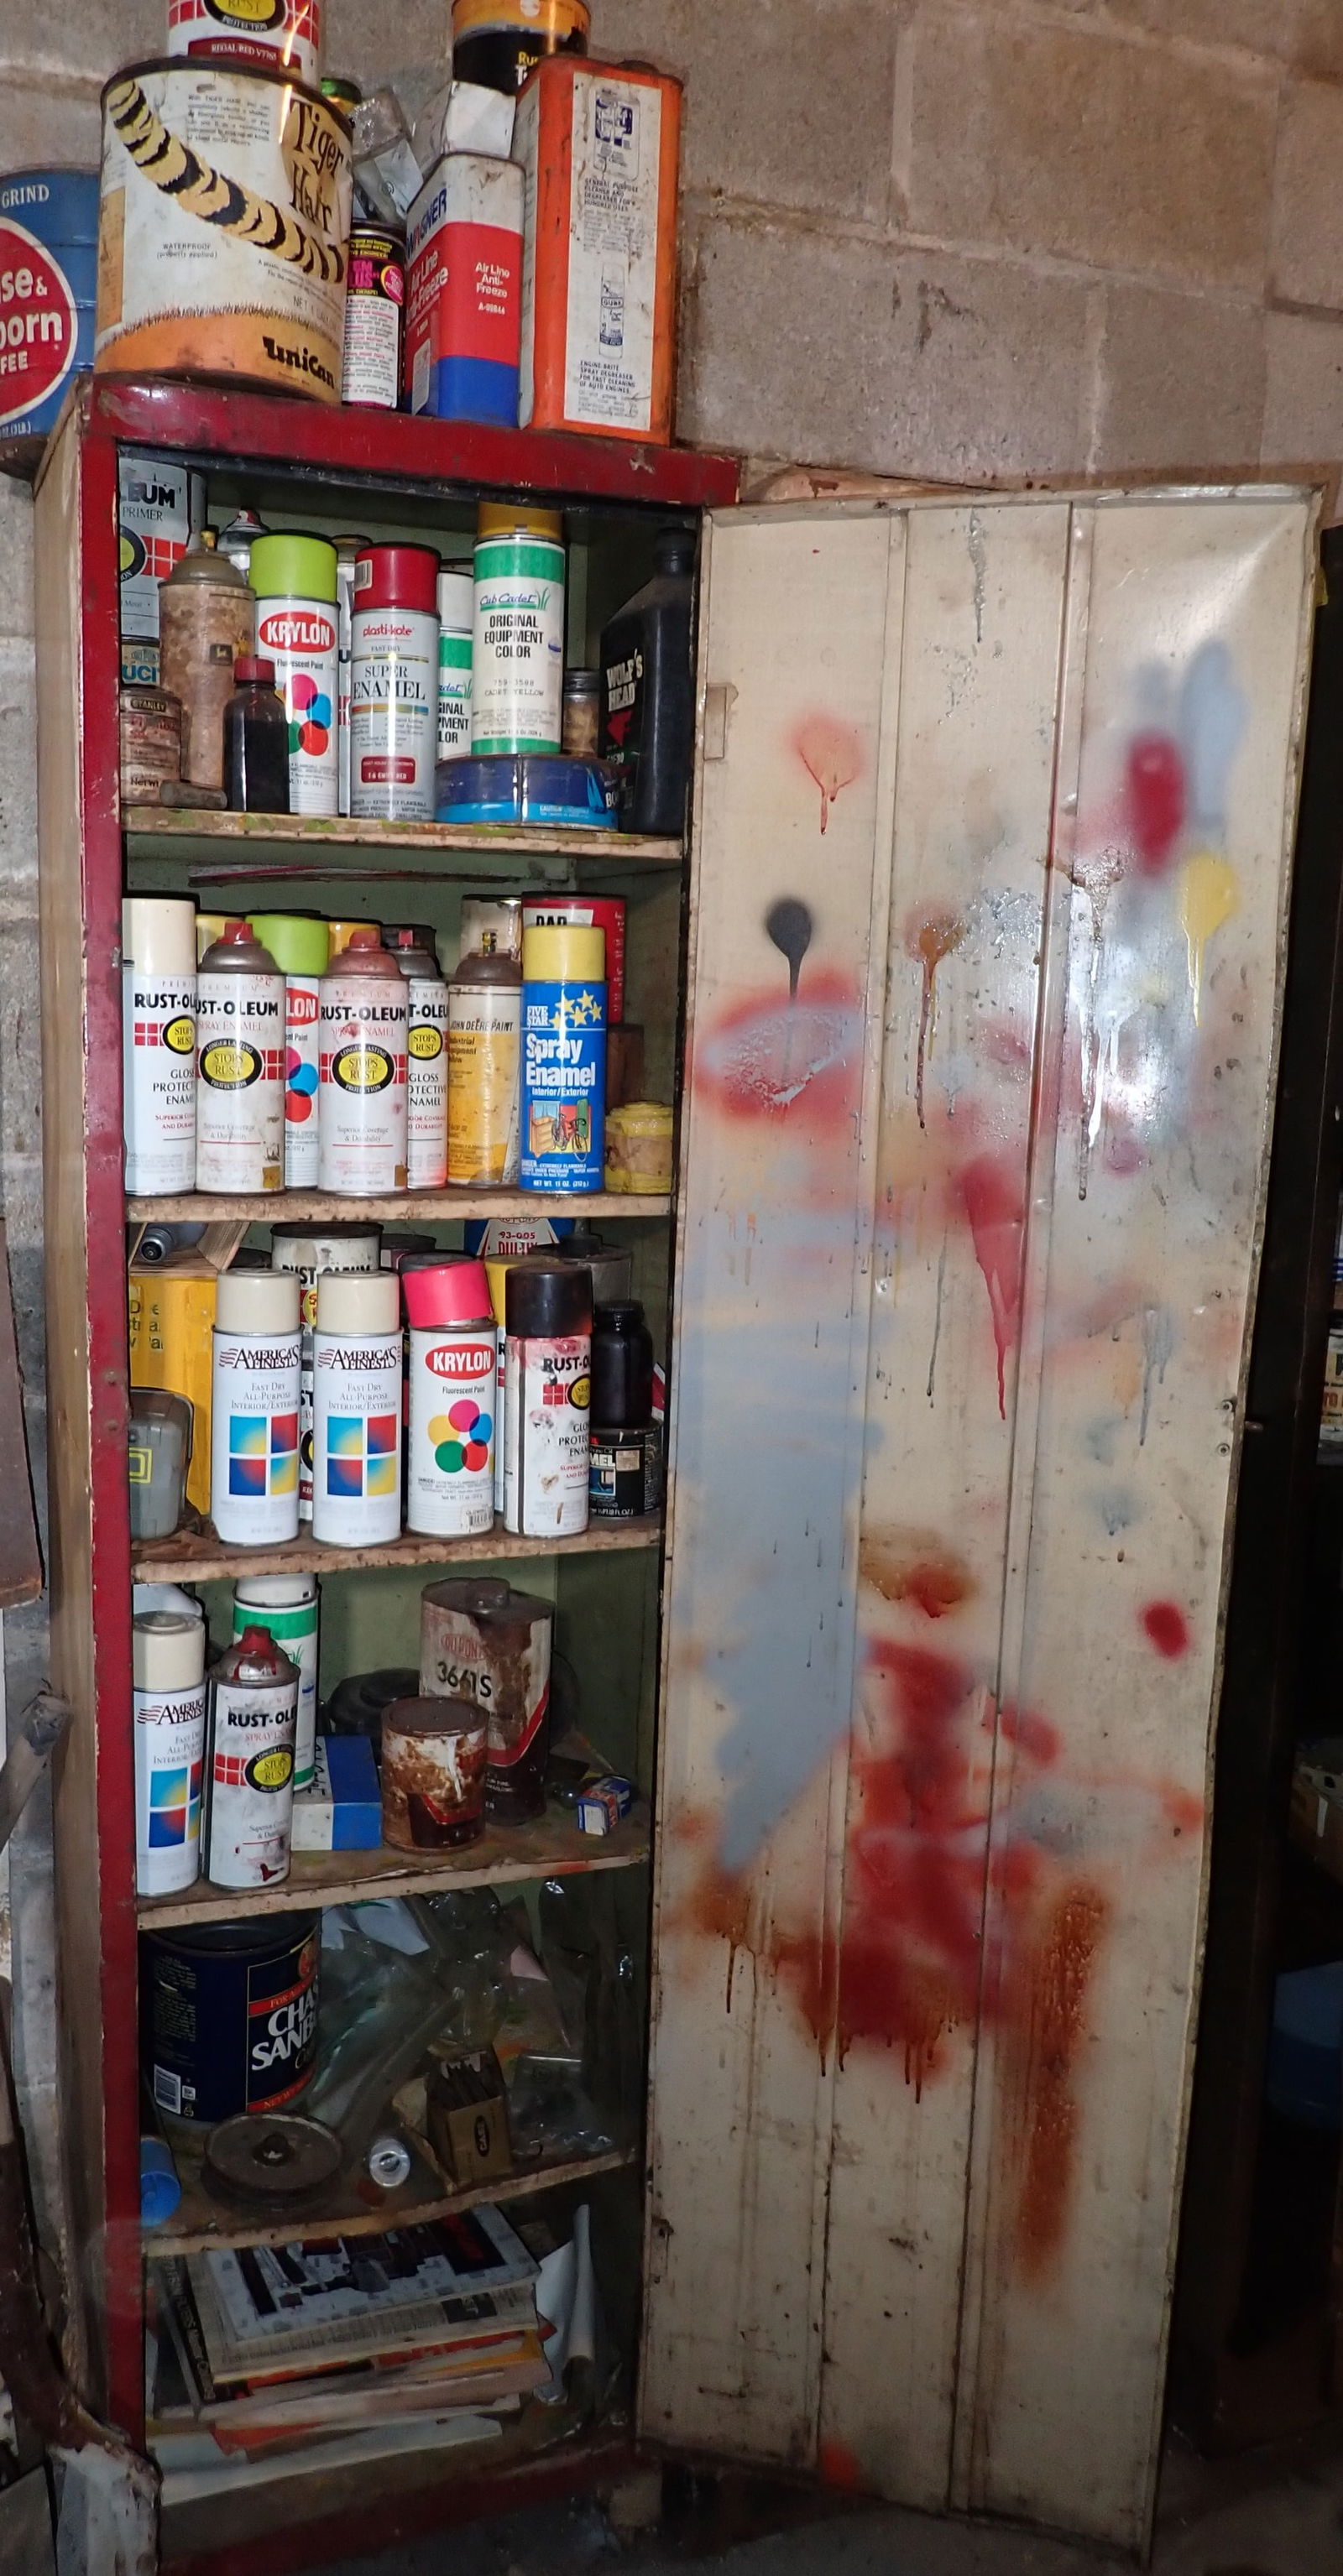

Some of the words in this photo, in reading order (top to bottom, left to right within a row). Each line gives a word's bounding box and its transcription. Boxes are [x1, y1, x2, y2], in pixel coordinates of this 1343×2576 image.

[238, 46, 254, 55] RED
[290, 98, 344, 180] Tiger
[2, 185, 50, 209] GRIND
[289, 159, 333, 235] Hair
[421, 250, 438, 283] Line
[475, 262, 489, 273] Air
[490, 263, 510, 279] Line
[481, 273, 504, 286] Anti-
[0, 268, 34, 305] se
[36, 274, 48, 297] &
[476, 284, 508, 299] Freeze
[581, 360, 601, 369] ENGINE
[604, 362, 619, 372] BRITE
[580, 367, 598, 376] SPRAY
[600, 369, 633, 380] DEGREASER
[580, 374, 591, 383] FOR
[592, 376, 607, 384] FAST
[608, 378, 635, 388] CLEANING
[588, 383, 604, 392] AUTO
[123, 507, 163, 522] PRIMER
[480, 594, 498, 606] Cub
[499, 592, 536, 604] Cadet
[489, 614, 538, 628] ORIGINAL
[267, 621, 330, 647] KRYLON
[484, 629, 544, 644] EQUIPMENT
[495, 644, 530, 658] COLOR
[311, 660, 324, 670] Paint
[365, 665, 408, 678] SUPER
[607, 648, 643, 689] WOLF'S
[353, 680, 426, 701] ENAMEL
[514, 689, 544, 697] YELLOW
[609, 682, 635, 712] HEAD
[131, 698, 166, 712] STANLEY
[527, 1006, 548, 1017] FIVE
[363, 1026, 395, 1037] NAMEL
[490, 1021, 514, 1032] PAINT
[295, 1033, 308, 1041] Paint
[367, 1046, 388, 1058] ASTING
[526, 1033, 583, 1065] Spray
[214, 1053, 243, 1063] STOPS
[349, 1057, 379, 1067] STOPS
[215, 1065, 242, 1075] RUST
[350, 1070, 377, 1080] RUST
[526, 1061, 595, 1087] Enamel
[409, 1072, 439, 1082] GLOSS
[532, 1087, 588, 1097] Interior/Exterior
[337, 1125, 360, 1134] Superior
[331, 1346, 397, 1370] AMERICA'S
[433, 1351, 491, 1372] KRYLON
[252, 1382, 269, 1391] FAST
[271, 1382, 285, 1391] DRY
[348, 1382, 365, 1391] FAST
[367, 1382, 382, 1391] DRY
[442, 1385, 473, 1395] Fluorescent
[474, 1385, 485, 1394] Paint
[340, 1392, 388, 1401] ALL-PURPOSE
[245, 1733, 272, 1741] SPRAY
[264, 1769, 285, 1781] RUST
